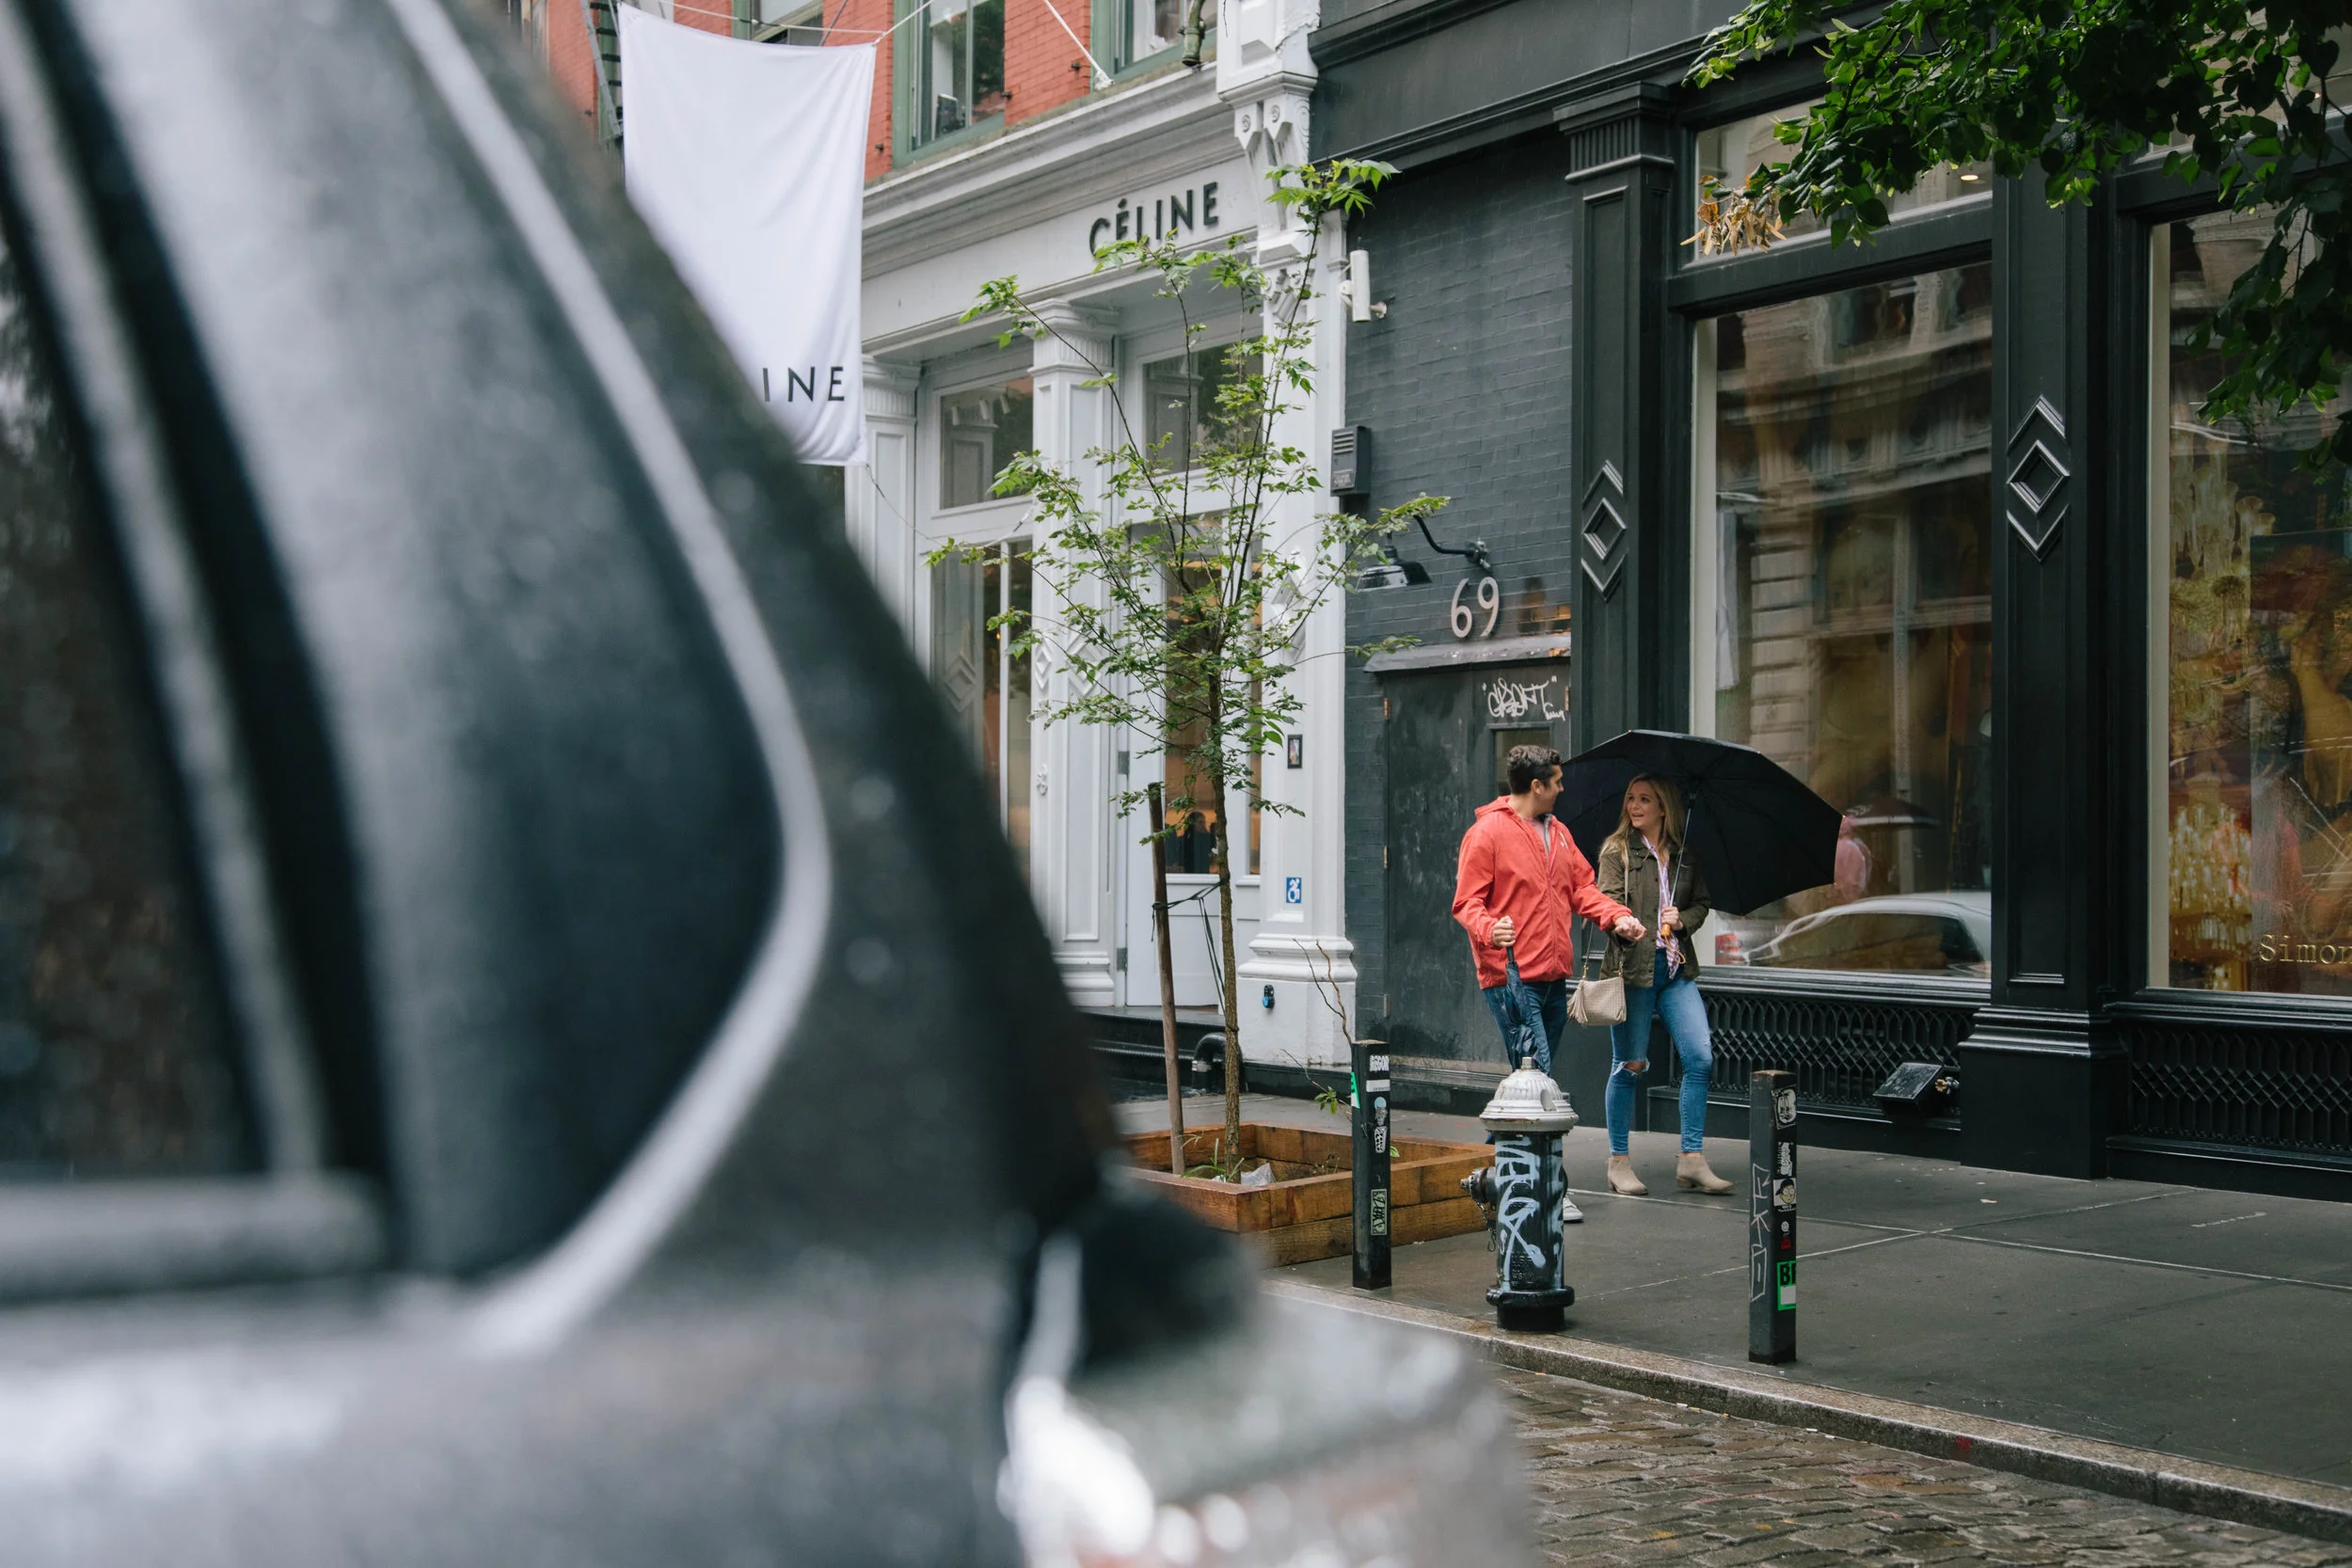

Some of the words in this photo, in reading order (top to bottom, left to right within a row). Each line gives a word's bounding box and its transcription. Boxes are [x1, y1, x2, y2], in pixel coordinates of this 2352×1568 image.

[1089, 182, 1218, 258] CÉLINE
[762, 366, 845, 403] INE
[1451, 576, 1500, 638] 69
